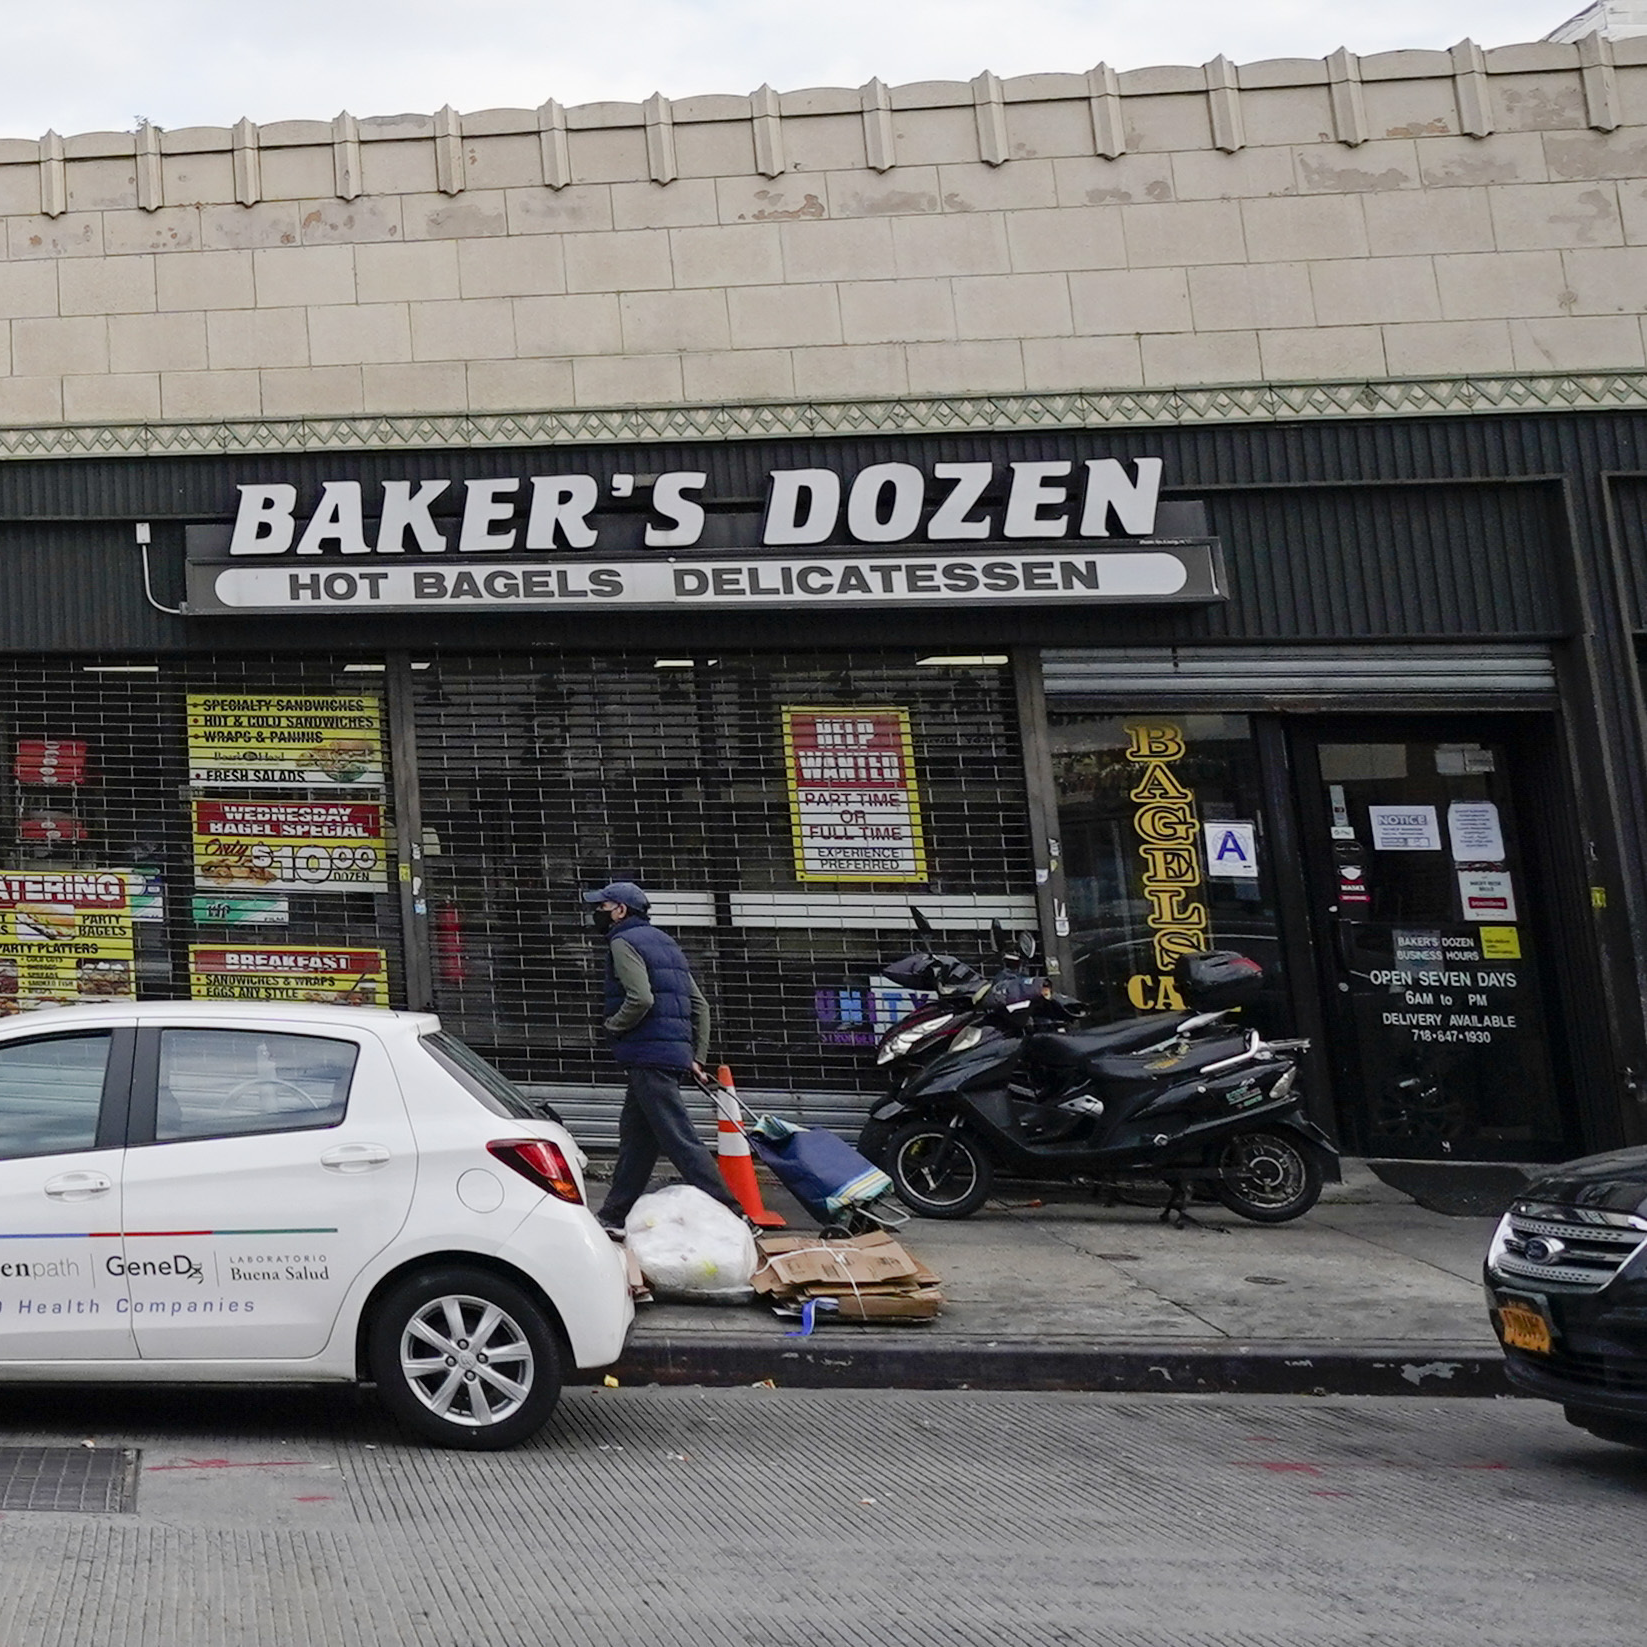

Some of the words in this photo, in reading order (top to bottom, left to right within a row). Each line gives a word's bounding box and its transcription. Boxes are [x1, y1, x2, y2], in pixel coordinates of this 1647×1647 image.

[229, 471, 706, 555] BAKER'S
[763, 457, 1163, 542] DOZEN
[289, 571, 390, 602] HOT
[413, 569, 624, 600] BAGELS
[673, 561, 1099, 598] DELICATESSEN
[203, 699, 272, 711] SPECIALTY
[277, 699, 364, 712] SANDWICHES
[233, 716, 244, 727] &
[247, 716, 281, 727] COLD
[286, 716, 374, 729] SANDWICHES
[204, 731, 252, 743] WRAPS
[256, 731, 266, 743] &
[270, 731, 324, 743] PANINIS
[815, 718, 874, 749] HELP
[798, 751, 901, 782] WANTED
[206, 770, 249, 782] FRESH
[253, 770, 306, 782] SALADS
[805, 793, 851, 806] PART
[856, 793, 901, 806] TIME
[224, 805, 353, 822] WEDNESDAY
[840, 810, 866, 824] OR
[209, 822, 277, 835] BAGEL
[282, 823, 369, 837] SPECIAL
[809, 826, 855, 840] FULL
[858, 827, 903, 840] TIME
[818, 847, 900, 858] EXPERIENCE
[1124, 723, 1207, 972] BAGELS
[1216, 831, 1247, 861] A
[820, 859, 900, 870] PREFERRED
[333, 872, 370, 882] DOZEN
[82, 914, 123, 925] PARTY
[79, 925, 127, 937] BAGELS
[38, 943, 99, 954] PLATTERS
[1397, 936, 1439, 947] BAKER'S
[1442, 937, 1474, 948] DOZEN
[225, 953, 351, 971] BREAKFAST
[1396, 950, 1443, 961] BUSINESS
[1446, 951, 1479, 961] HOURS
[206, 975, 281, 986] SANDWICHES
[284, 976, 292, 986] &
[294, 976, 335, 987] WRAPS
[1370, 970, 1413, 986] OPEN
[1419, 971, 1471, 987] SEVEN
[1477, 972, 1517, 988] DAYS
[206, 987, 235, 998] EGGS
[238, 987, 260, 998] ANY
[265, 988, 298, 998] STYLE
[1405, 990, 1434, 1005] 6AM
[1440, 994, 1453, 1006] to
[1468, 994, 1488, 1006] PM
[1382, 1012, 1442, 1026] DELIVERY
[1449, 1015, 1517, 1028] AVAILABLE
[229, 1254, 328, 1264] LABORATORIO
[230, 1267, 281, 1281] Buena
[285, 1266, 330, 1281] Salud
[18, 1299, 100, 1314] Health
[116, 1298, 256, 1317] Companies
